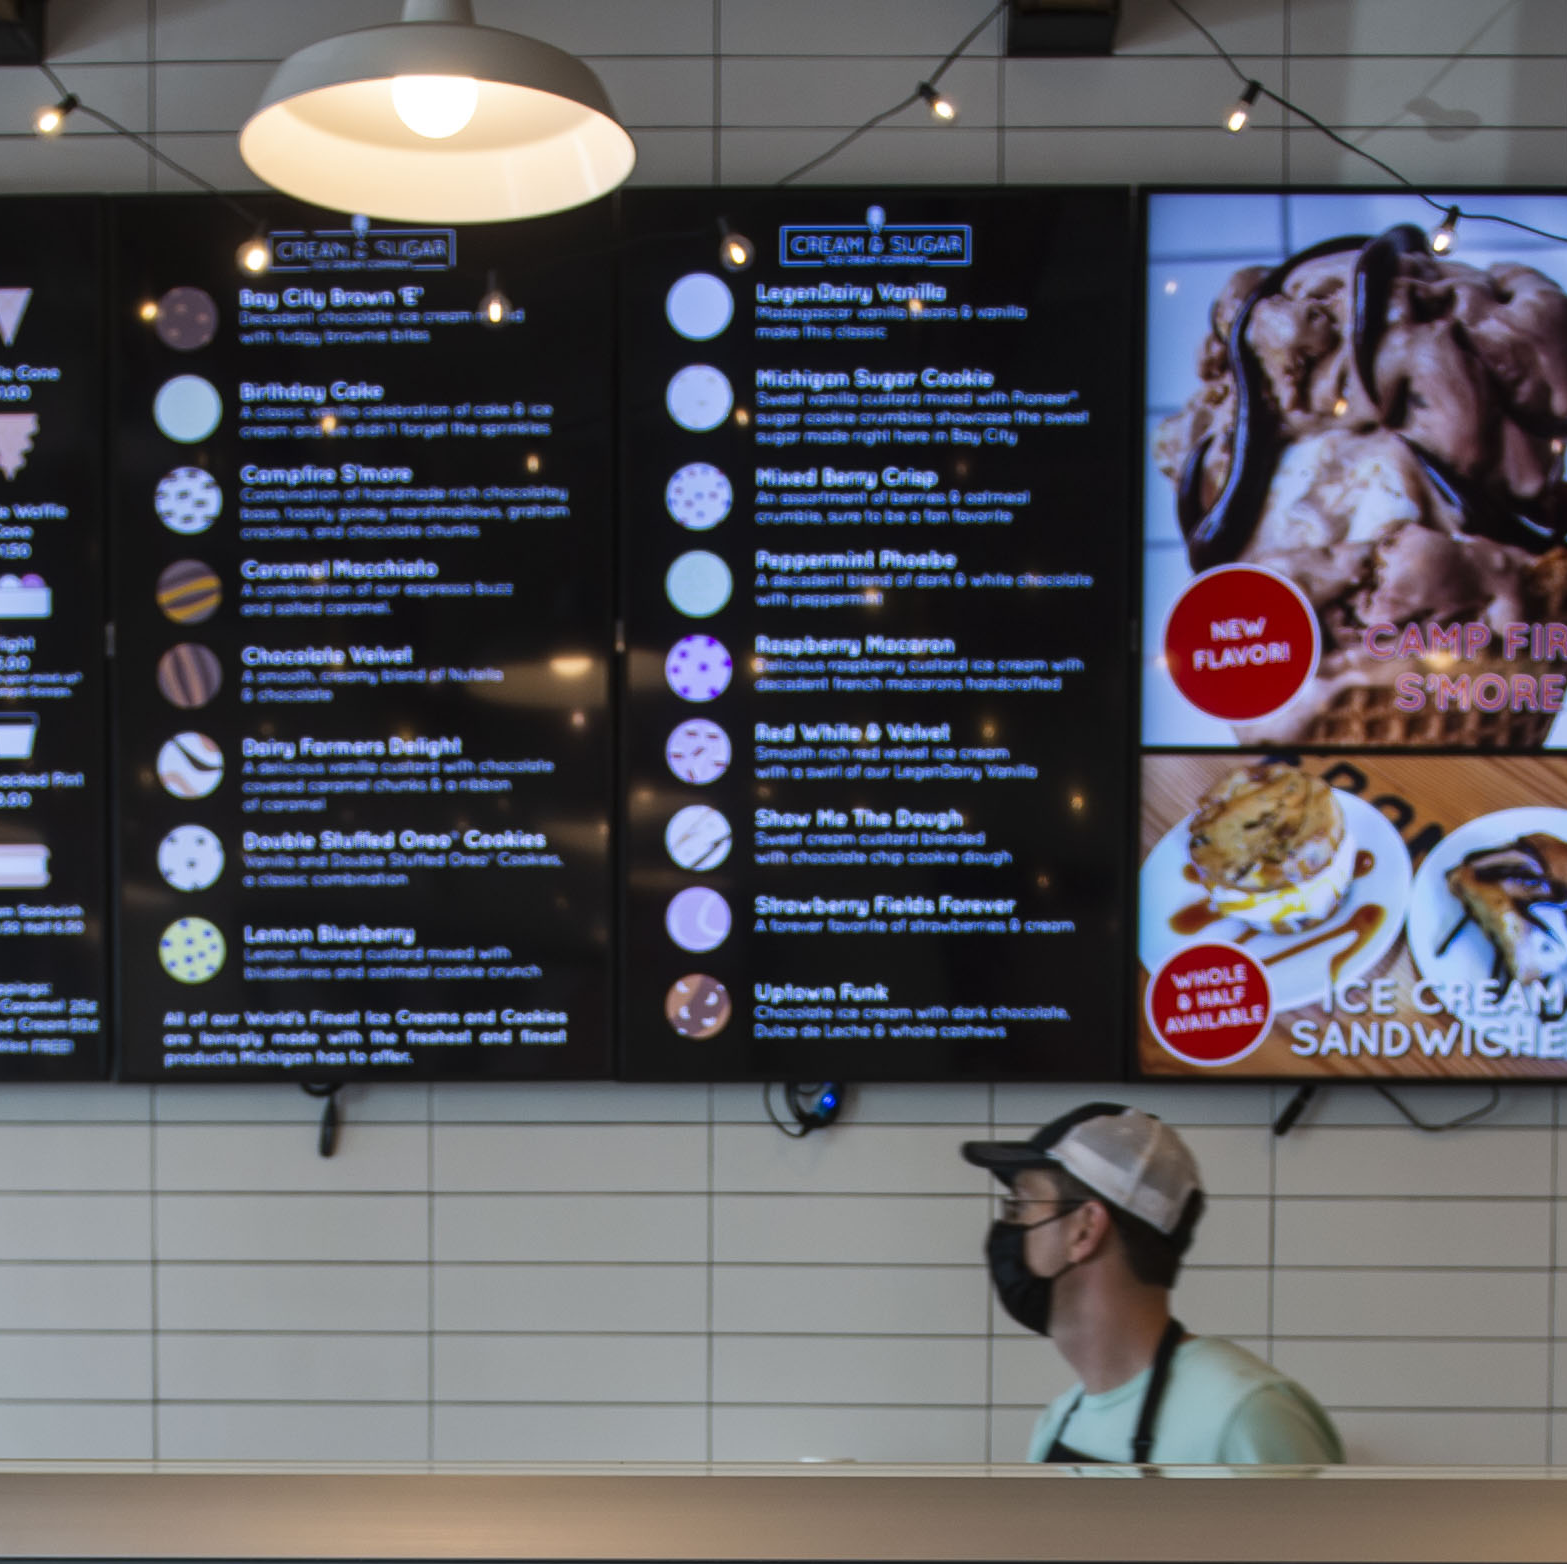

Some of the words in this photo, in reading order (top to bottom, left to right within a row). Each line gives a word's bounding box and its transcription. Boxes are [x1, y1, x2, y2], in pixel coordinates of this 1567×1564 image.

[791, 236, 864, 255] CREAM
[869, 236, 884, 255] &
[886, 235, 962, 257] SUGAR
[240, 289, 278, 310] Bay
[282, 288, 326, 309] City
[330, 288, 394, 306] Brown
[757, 283, 872, 306] LegenDairy
[877, 283, 946, 305] Vanilla
[756, 369, 849, 391] Michigan
[854, 368, 917, 391] Sugar
[921, 368, 994, 387] Cookie
[240, 382, 326, 403] Birthday
[330, 381, 384, 400] Cake
[240, 465, 336, 486] Campfire
[341, 464, 412, 483] S'more
[756, 468, 817, 486] Mixed
[822, 467, 878, 489] Berry
[882, 466, 938, 488] Crisp
[241, 560, 330, 579] Caramel
[333, 559, 438, 578] Macchiato
[1211, 617, 1265, 639] NEW
[755, 635, 861, 657] Raspberry
[866, 635, 955, 654] Macaron
[1364, 623, 1491, 661] CAMP
[242, 646, 345, 665] Chocolate
[349, 646, 412, 664] Velvet
[1194, 642, 1290, 669] FLAVOR!
[1394, 673, 1566, 712] S'MORE
[755, 723, 795, 742] Red
[800, 723, 862, 741] White
[865, 723, 882, 741] &
[886, 723, 950, 741] Velvet
[242, 738, 296, 759] Dairy
[300, 737, 385, 756] Farmers
[389, 736, 461, 758] Delight
[755, 808, 811, 827] Show
[817, 809, 848, 827] Me
[852, 808, 892, 827] The
[896, 808, 963, 830] Dough
[243, 832, 316, 851] Double
[320, 831, 395, 849] Stuffed
[464, 829, 546, 848] Cookies
[755, 896, 869, 917] Strawberry
[874, 896, 935, 914] Fields
[939, 895, 1016, 913] Forever
[244, 925, 313, 943] Lemon
[318, 924, 415, 945] Blueberry
[1172, 965, 1247, 993] WHOLE
[755, 984, 835, 1004] Uptown
[840, 983, 888, 1001] Funk
[1179, 994, 1191, 1010] &
[1197, 986, 1244, 1007] HALF
[1322, 980, 1397, 1015] ICE
[1412, 979, 1565, 1016] CREAM
[1165, 1005, 1263, 1035] AVAILABLE
